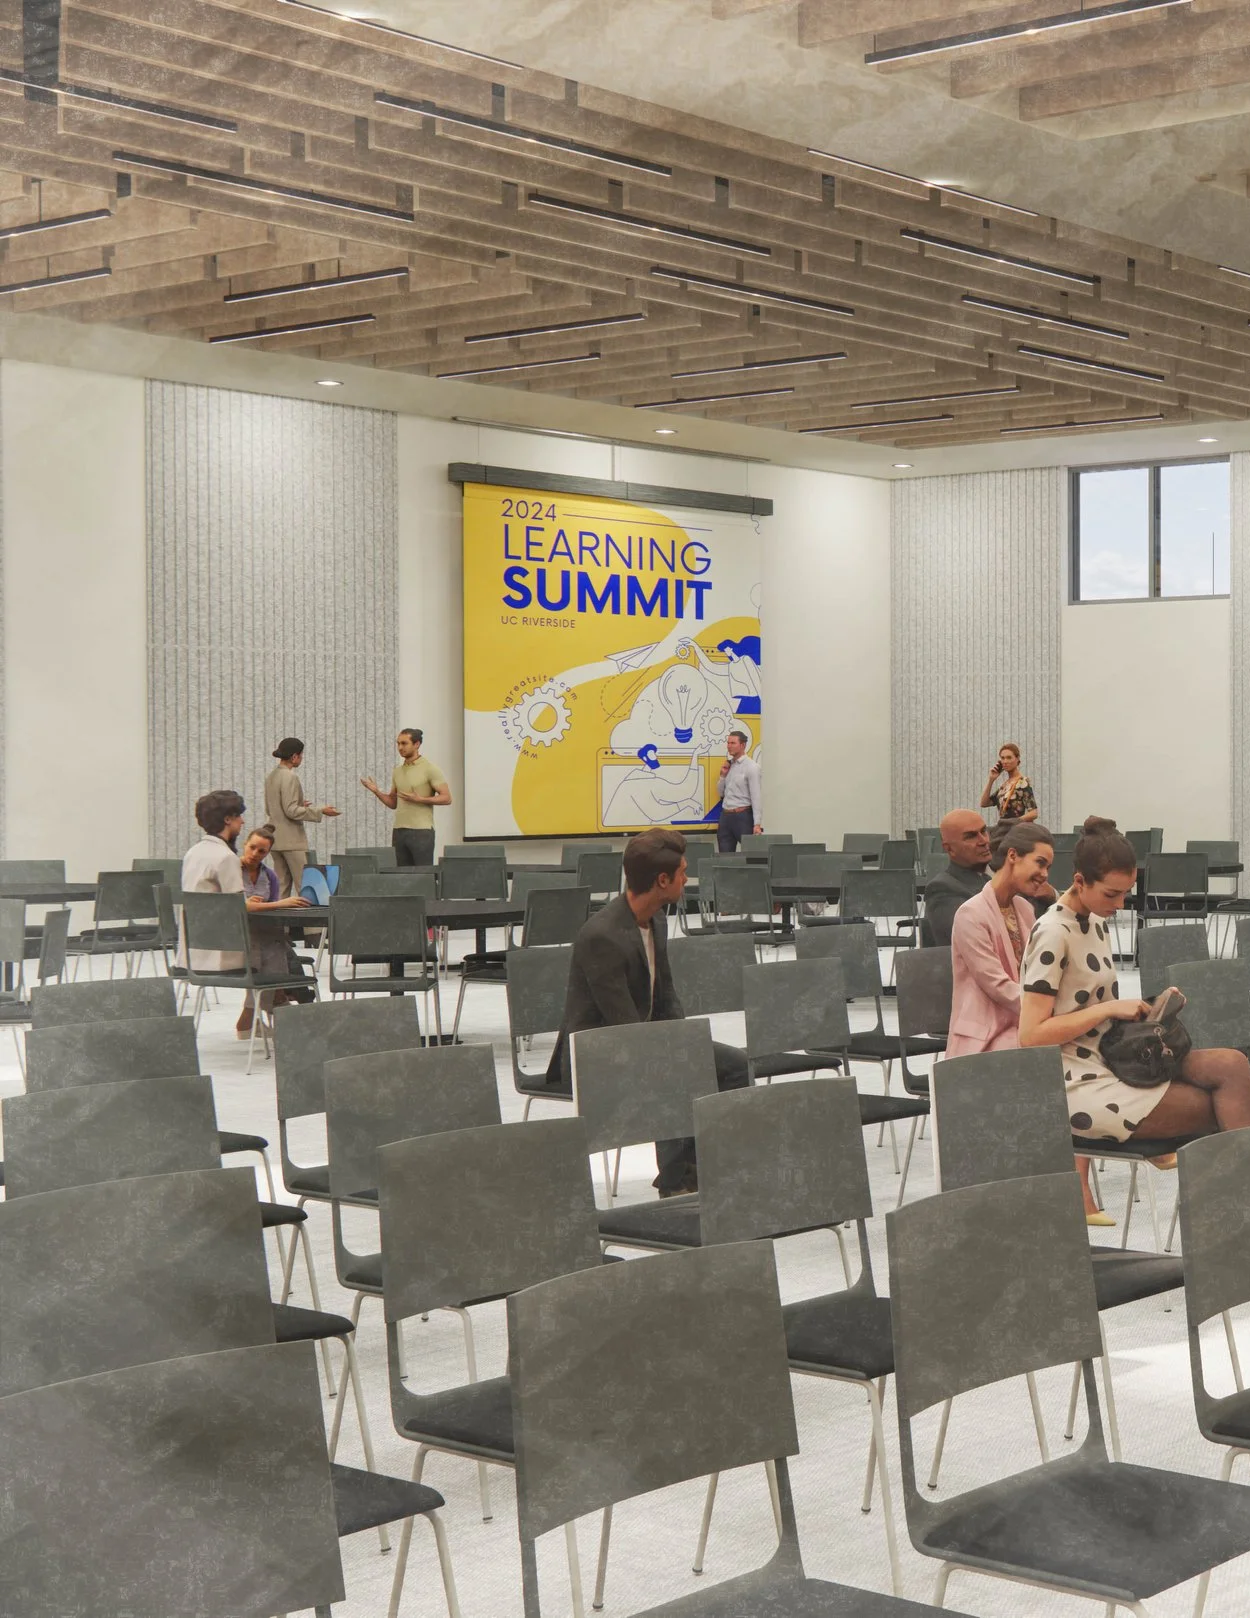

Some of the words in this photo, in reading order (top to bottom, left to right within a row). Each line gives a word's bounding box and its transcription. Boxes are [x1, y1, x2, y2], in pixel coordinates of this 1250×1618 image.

[501, 499, 557, 521] 2024
[504, 523, 712, 576] LEARNING
[502, 565, 713, 620] SUMMIT
[501, 616, 518, 626] UC
[522, 616, 576, 629] RIVERSIDE
